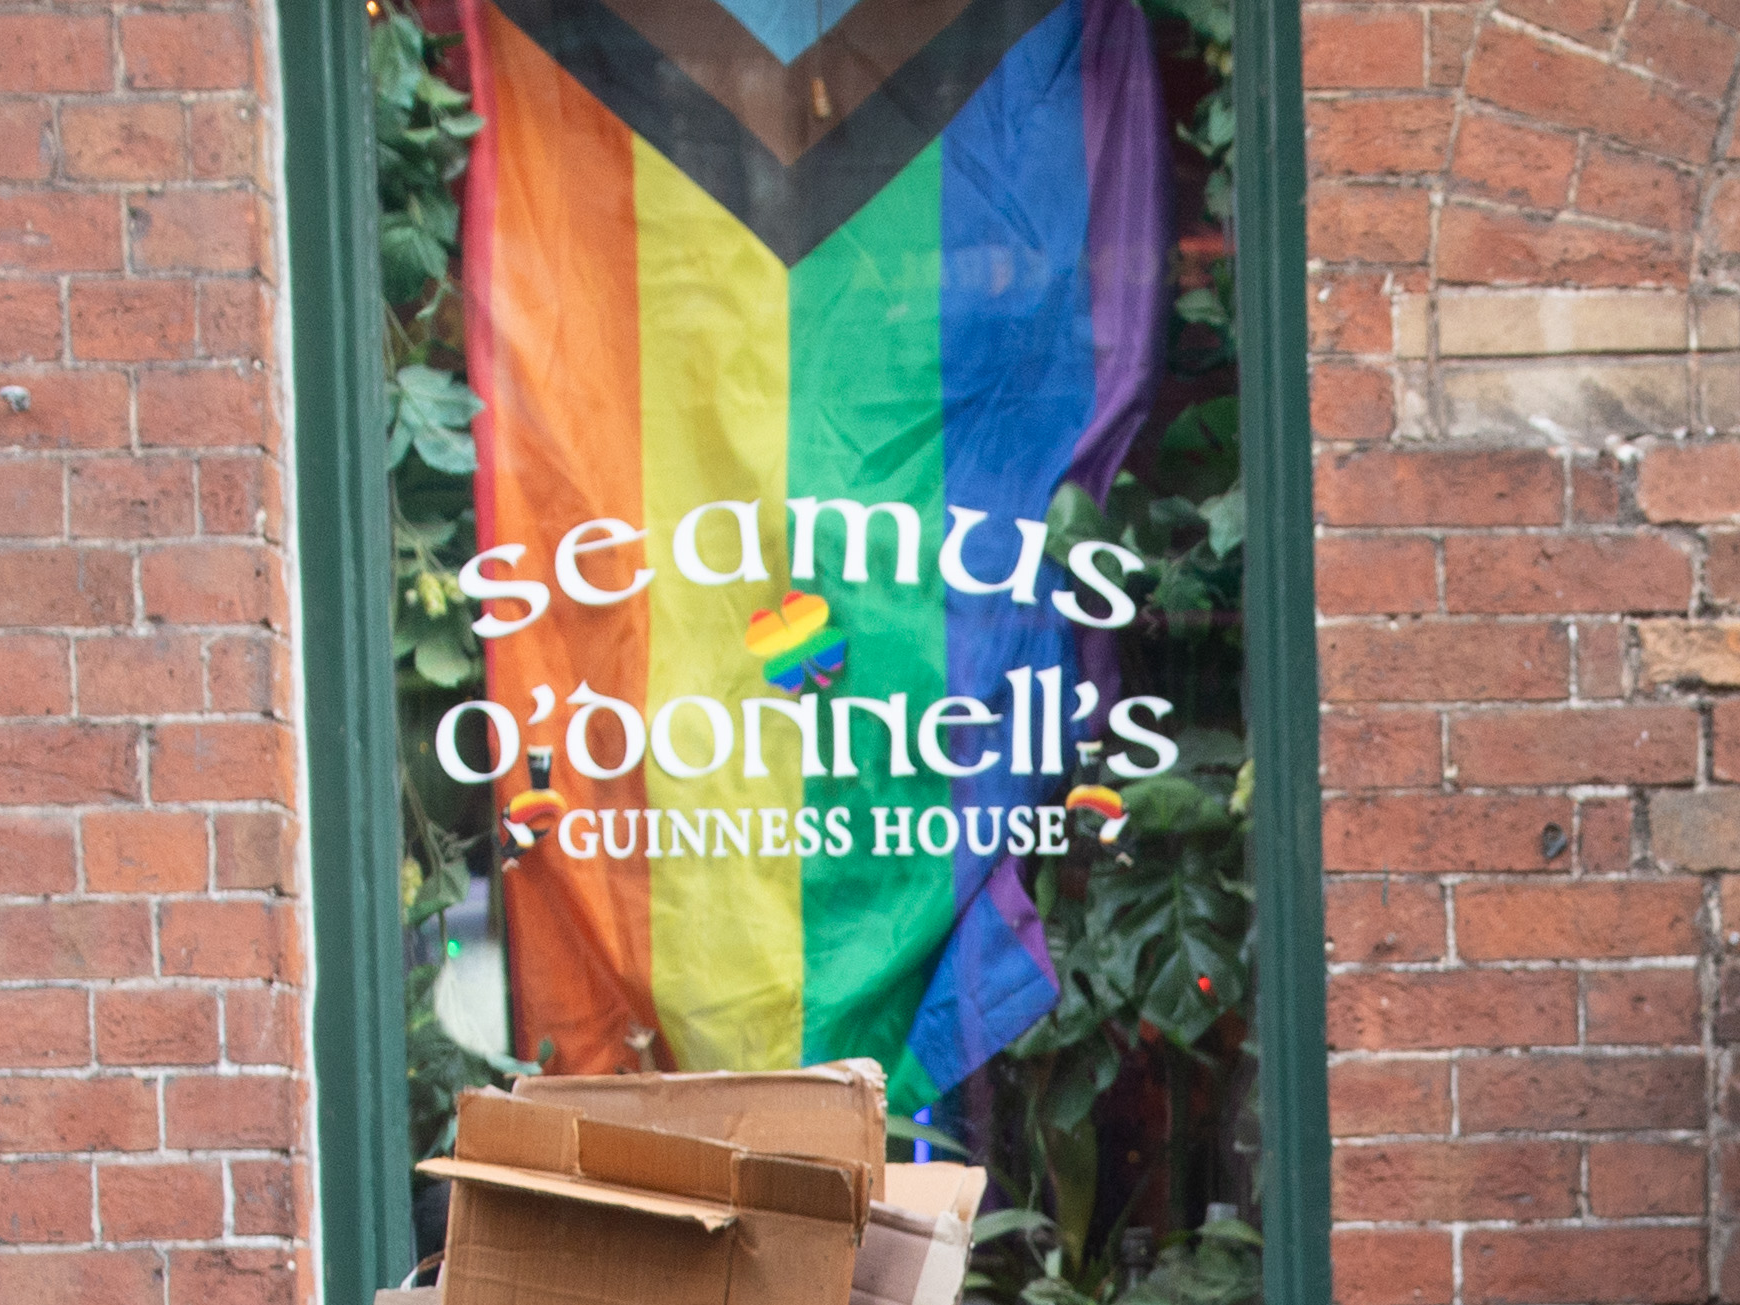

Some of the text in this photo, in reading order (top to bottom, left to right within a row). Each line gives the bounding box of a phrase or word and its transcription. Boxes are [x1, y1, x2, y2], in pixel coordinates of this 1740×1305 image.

[458, 496, 1145, 637] seamus
[557, 803, 1071, 860] GUINNESS HOUSE
